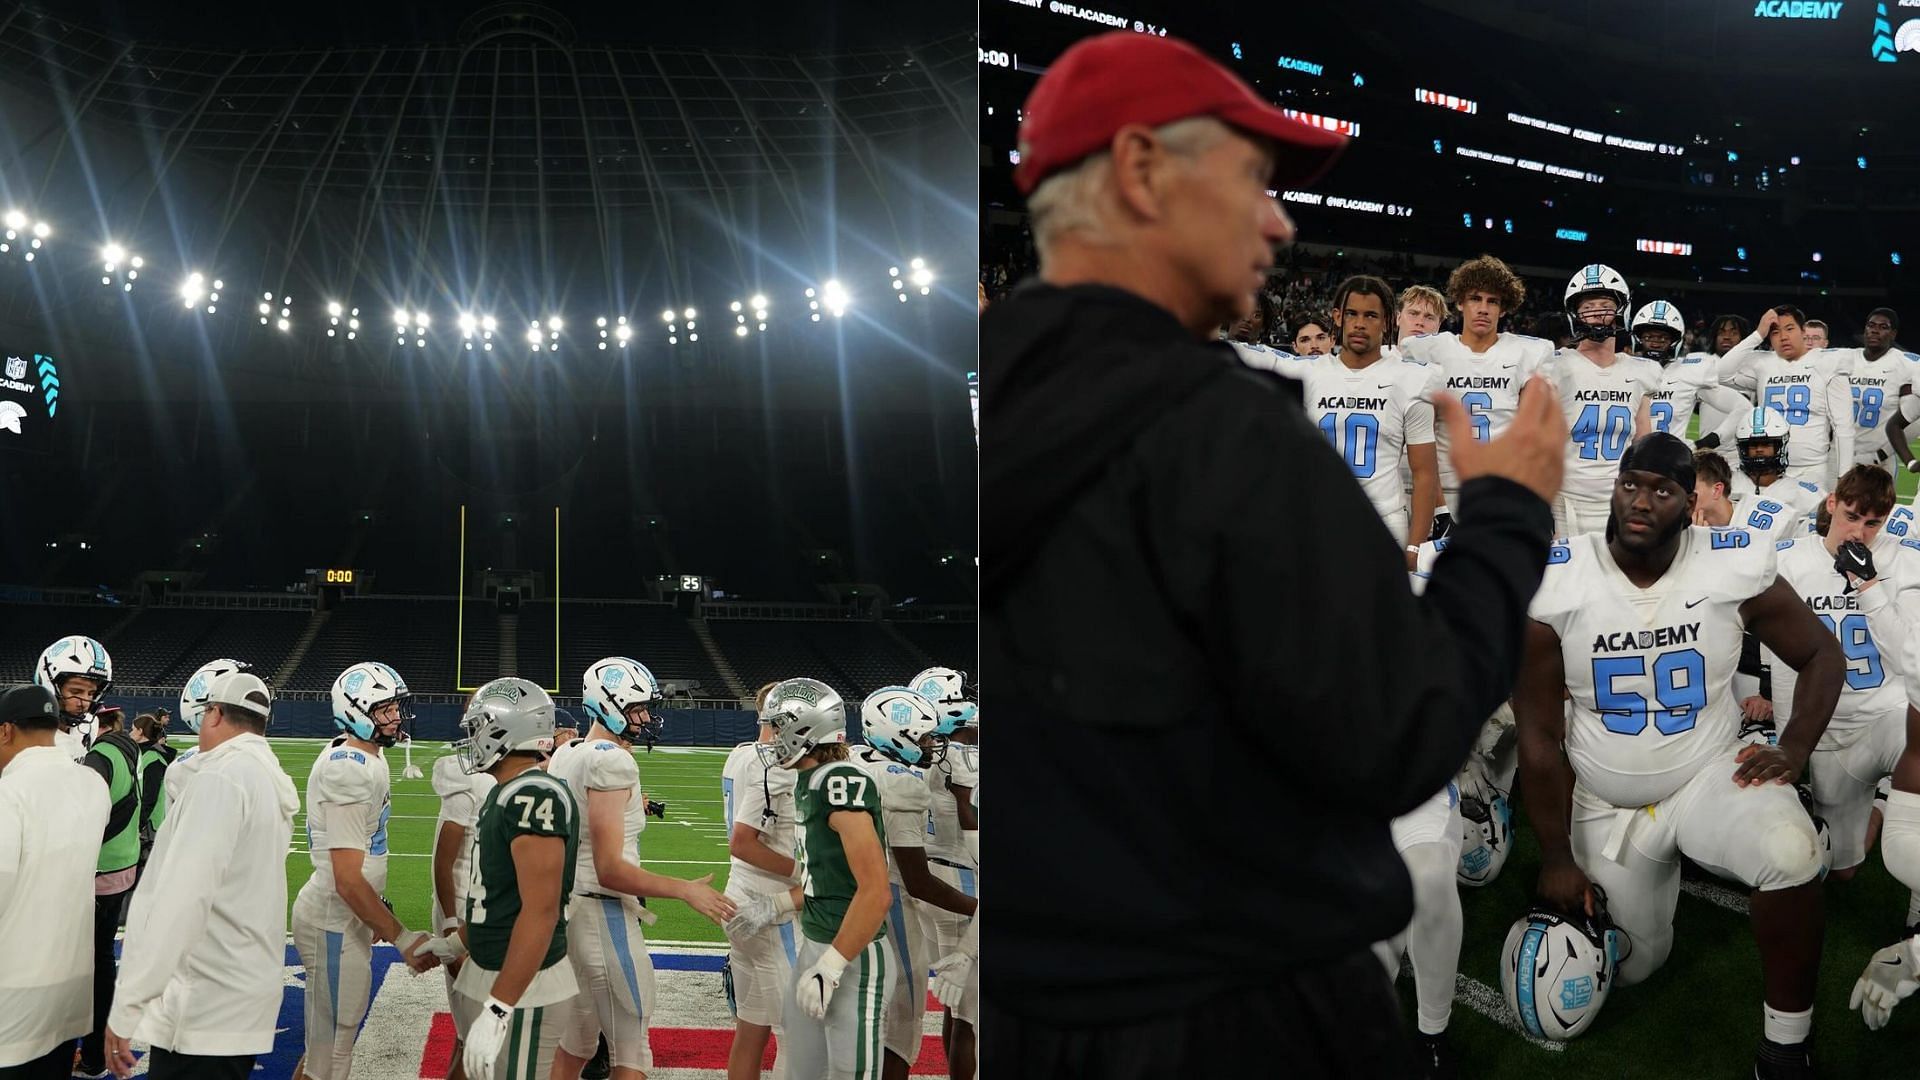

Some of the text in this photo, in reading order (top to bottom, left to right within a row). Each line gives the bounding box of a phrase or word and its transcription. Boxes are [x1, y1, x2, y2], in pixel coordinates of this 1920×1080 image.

[1050, 1, 1129, 29] @NFLACADEMY
[1754, 1, 1842, 19] ACADEMY
[1278, 56, 1324, 76] ACADEMY
[1282, 190, 1322, 205] ACADEMY
[1326, 196, 1384, 213] @NFLACADEMY
[1555, 229, 1588, 241] ACADEMY
[1446, 377, 1511, 389] ACADEMY
[1767, 374, 1811, 385] ACADEMY
[1318, 397, 1388, 411] ACADEMY
[1575, 390, 1632, 402] ACADEMY
[1764, 385, 1810, 426] 58
[1571, 404, 1632, 461] 40
[1319, 412, 1380, 479] 10
[327, 570, 353, 583] 0:00
[683, 577, 699, 590] 25
[1593, 622, 1701, 653] ACADEMY
[1591, 648, 1708, 736] 59
[827, 775, 867, 806] 87
[514, 795, 554, 831] 74
